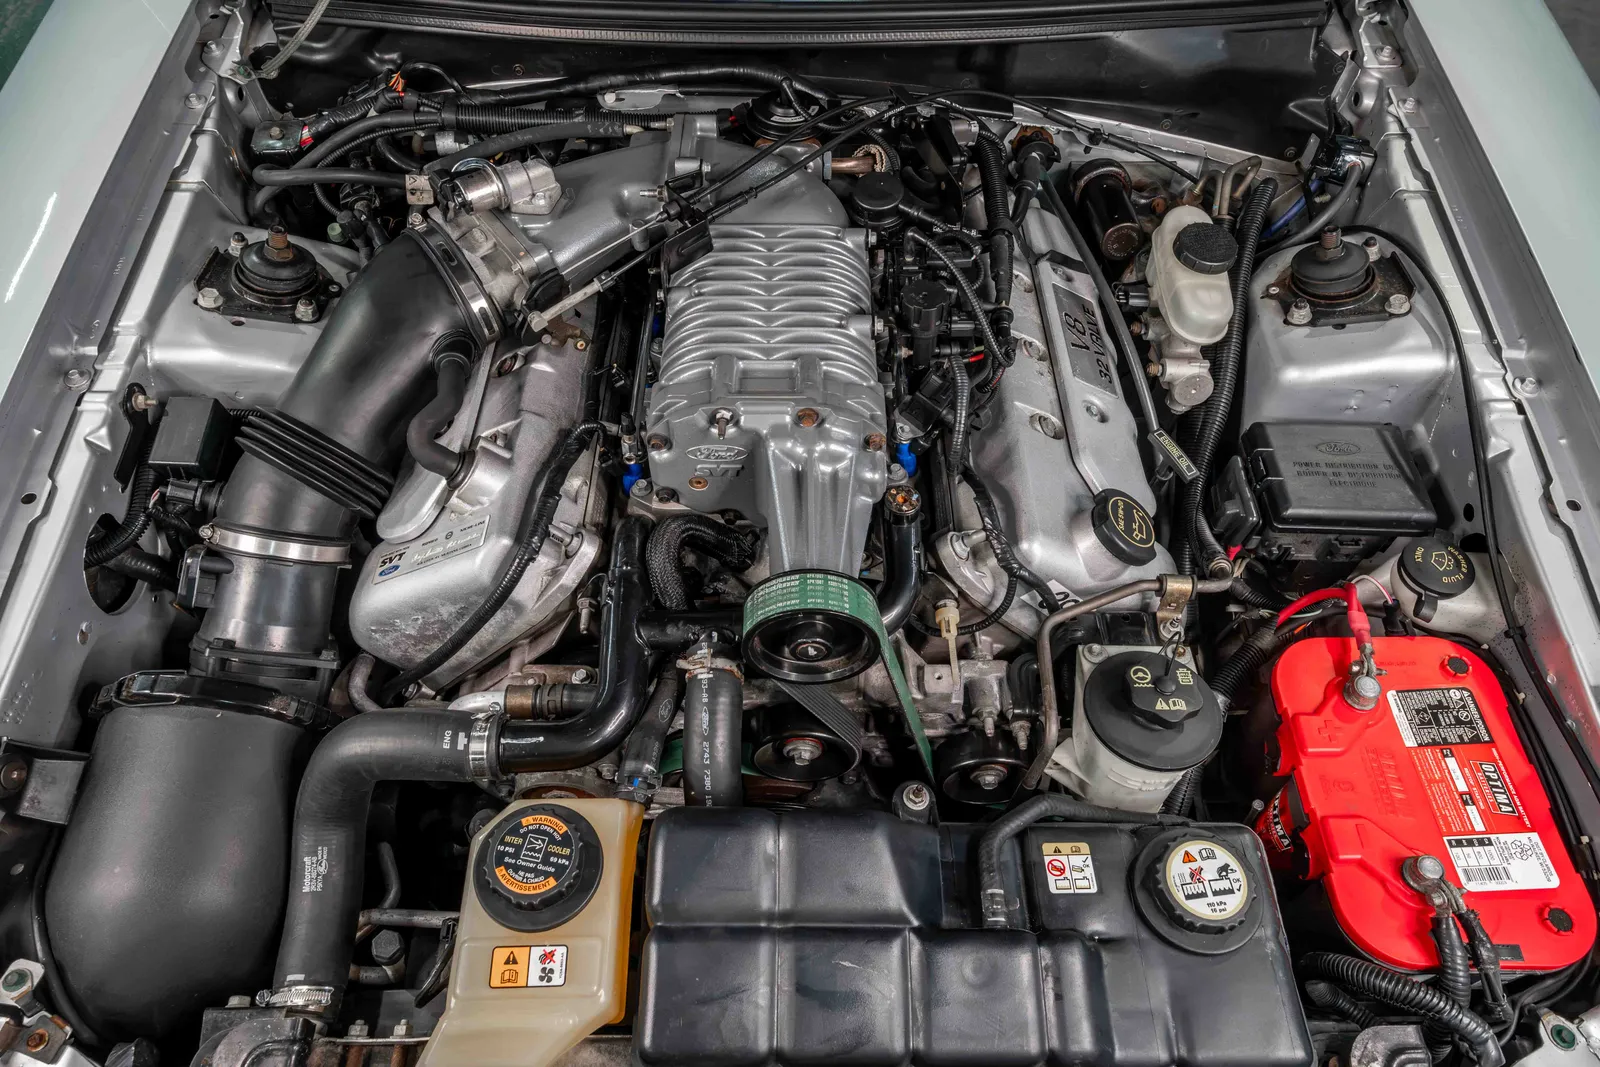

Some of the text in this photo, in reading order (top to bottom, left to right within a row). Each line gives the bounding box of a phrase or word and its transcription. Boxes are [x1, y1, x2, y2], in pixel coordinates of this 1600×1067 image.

[1063, 311, 1090, 352] V8
[1082, 304, 1112, 384] 32 VALVE
[692, 445, 743, 461] Ford
[1160, 436, 1190, 469] ENGINE OIL
[695, 463, 744, 477] SVT
[379, 551, 407, 568] SVT
[1415, 547, 1424, 562] ONLY
[1442, 546, 1468, 583] WASHER FLUID
[1465, 696, 1490, 741] DANGER/POISON
[442, 730, 452, 749] ENG
[1478, 772, 1493, 802] BATTERIES
[1481, 764, 1513, 812] OPTIMA
[520, 826, 528, 834] DO
[540, 824, 554, 834] OPEN
[552, 830, 562, 842] HOT
[532, 816, 564, 832] WARNING
[504, 836, 523, 845] INTER
[548, 844, 570, 856] COOLER
[516, 860, 536, 868] Owner
[537, 864, 556, 873] Guide
[558, 858, 570, 866] kPa
[302, 856, 311, 892] Motorcraft
[501, 874, 552, 892] AVERTISSEMENT
